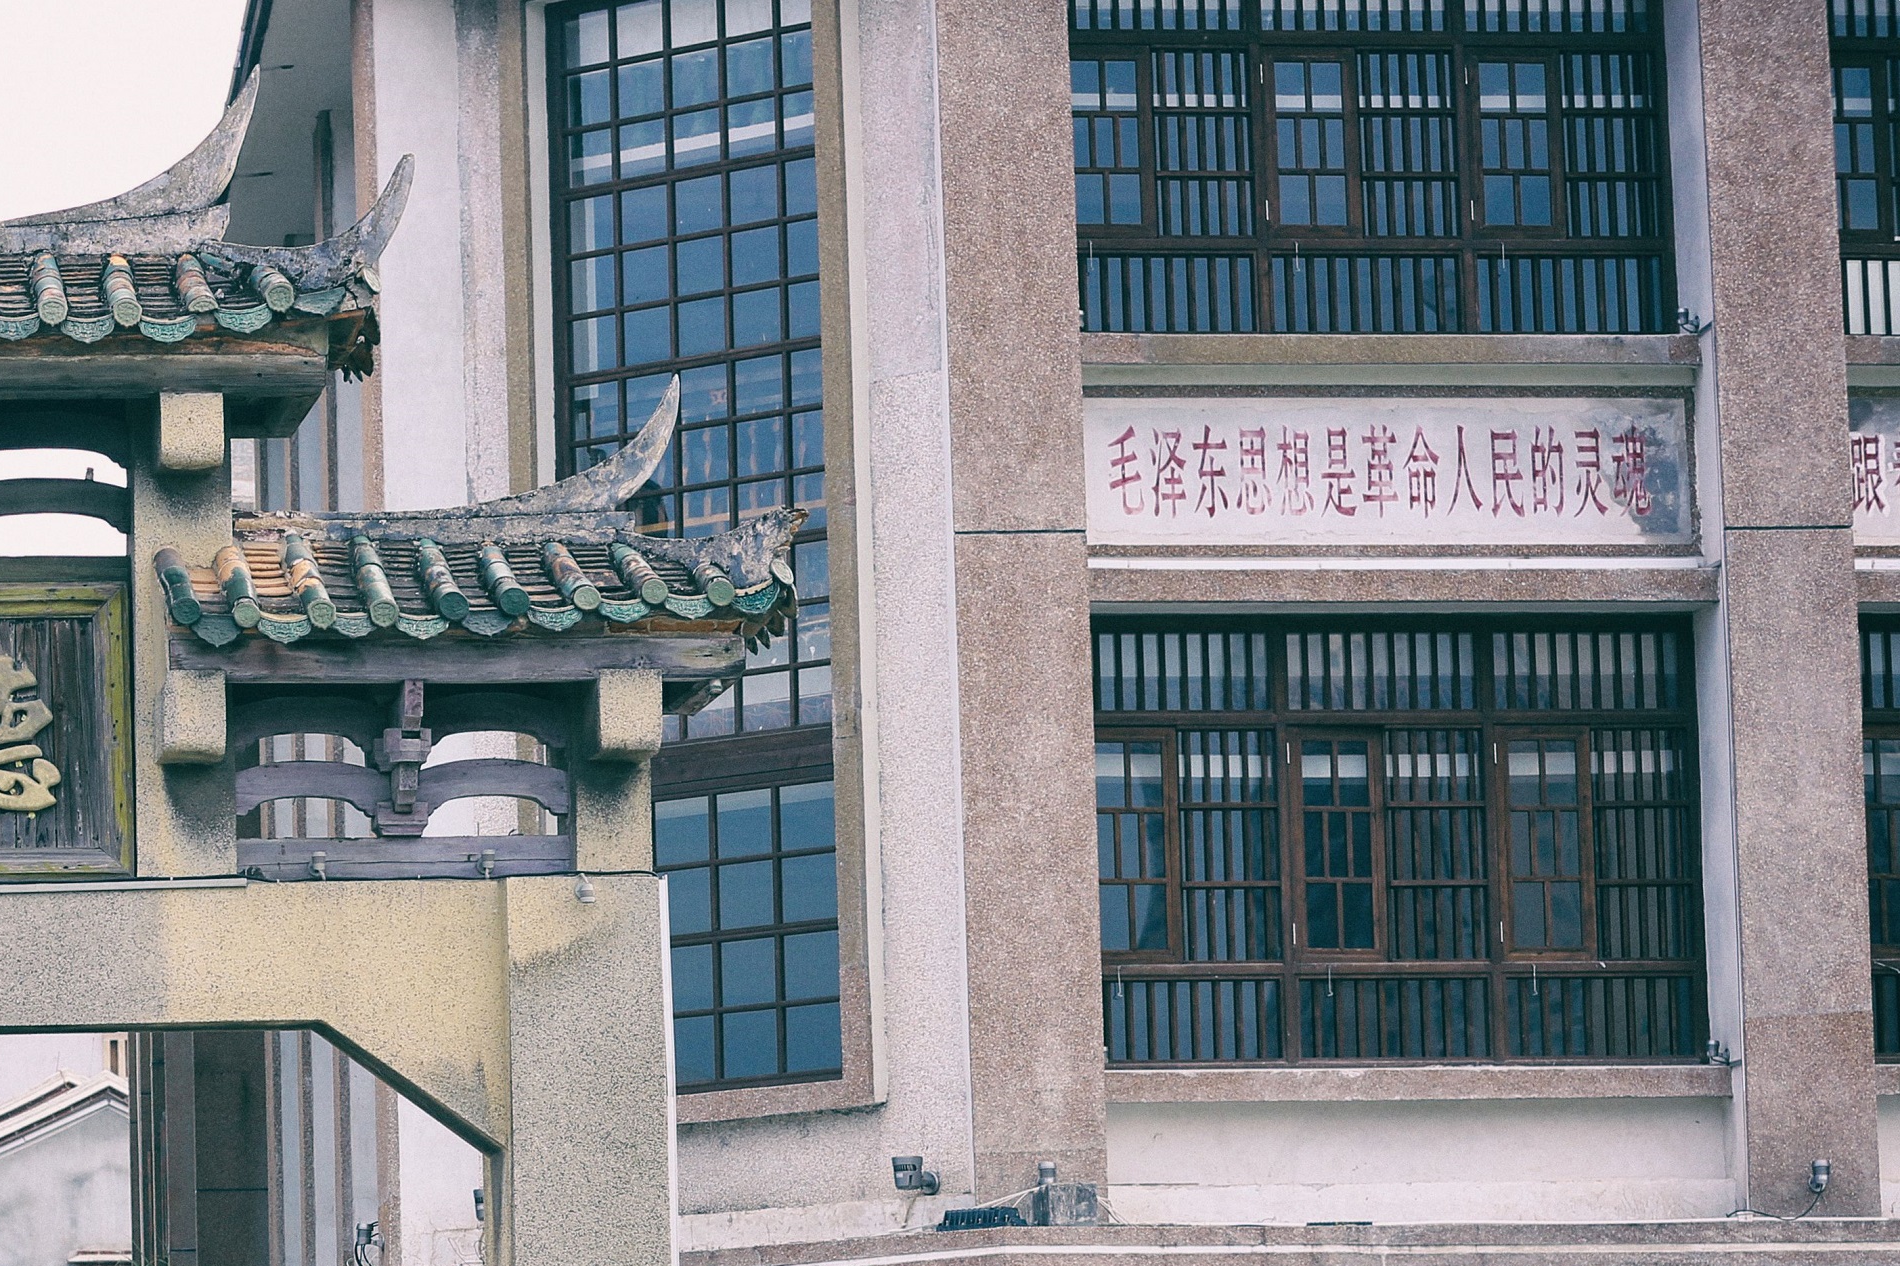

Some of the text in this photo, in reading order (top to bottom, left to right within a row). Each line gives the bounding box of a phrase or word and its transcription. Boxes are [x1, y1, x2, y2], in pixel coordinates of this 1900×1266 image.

[1107, 424, 1652, 519] 毛泽东思想是革命人民的灵魂
